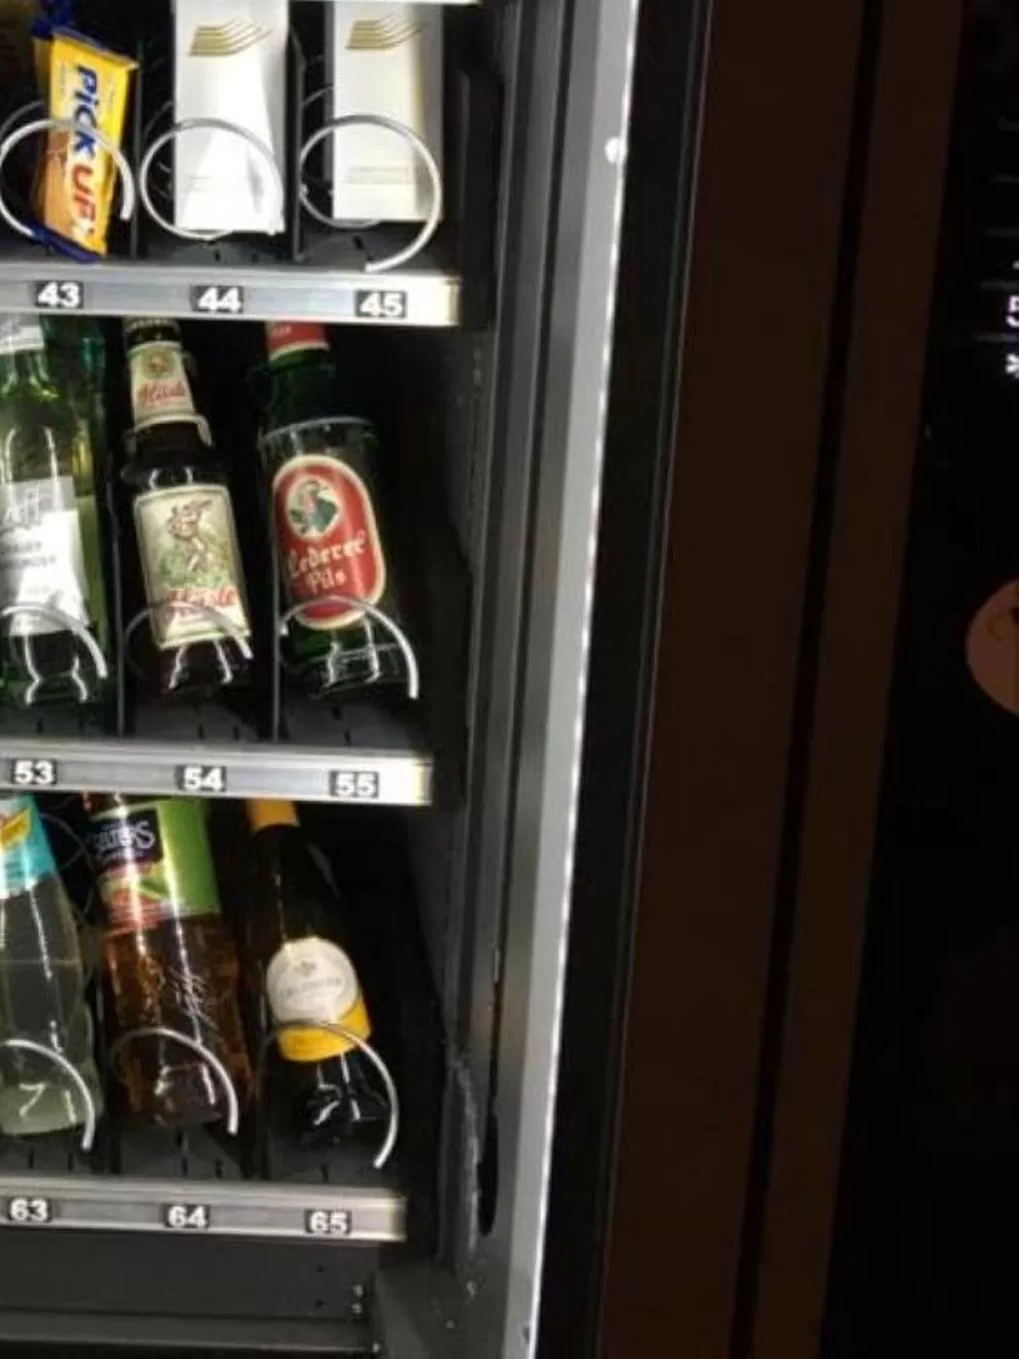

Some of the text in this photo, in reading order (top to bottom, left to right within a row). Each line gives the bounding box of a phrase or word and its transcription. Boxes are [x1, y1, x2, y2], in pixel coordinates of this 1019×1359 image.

[37, 283, 80, 307] 43
[197, 288, 241, 312] 44
[360, 292, 403, 317] 45
[14, 761, 53, 784] 53
[183, 767, 222, 791] 54
[336, 773, 376, 796] 55
[11, 1200, 48, 1222] 63
[168, 1207, 207, 1228] 64
[310, 1213, 348, 1235] 65
